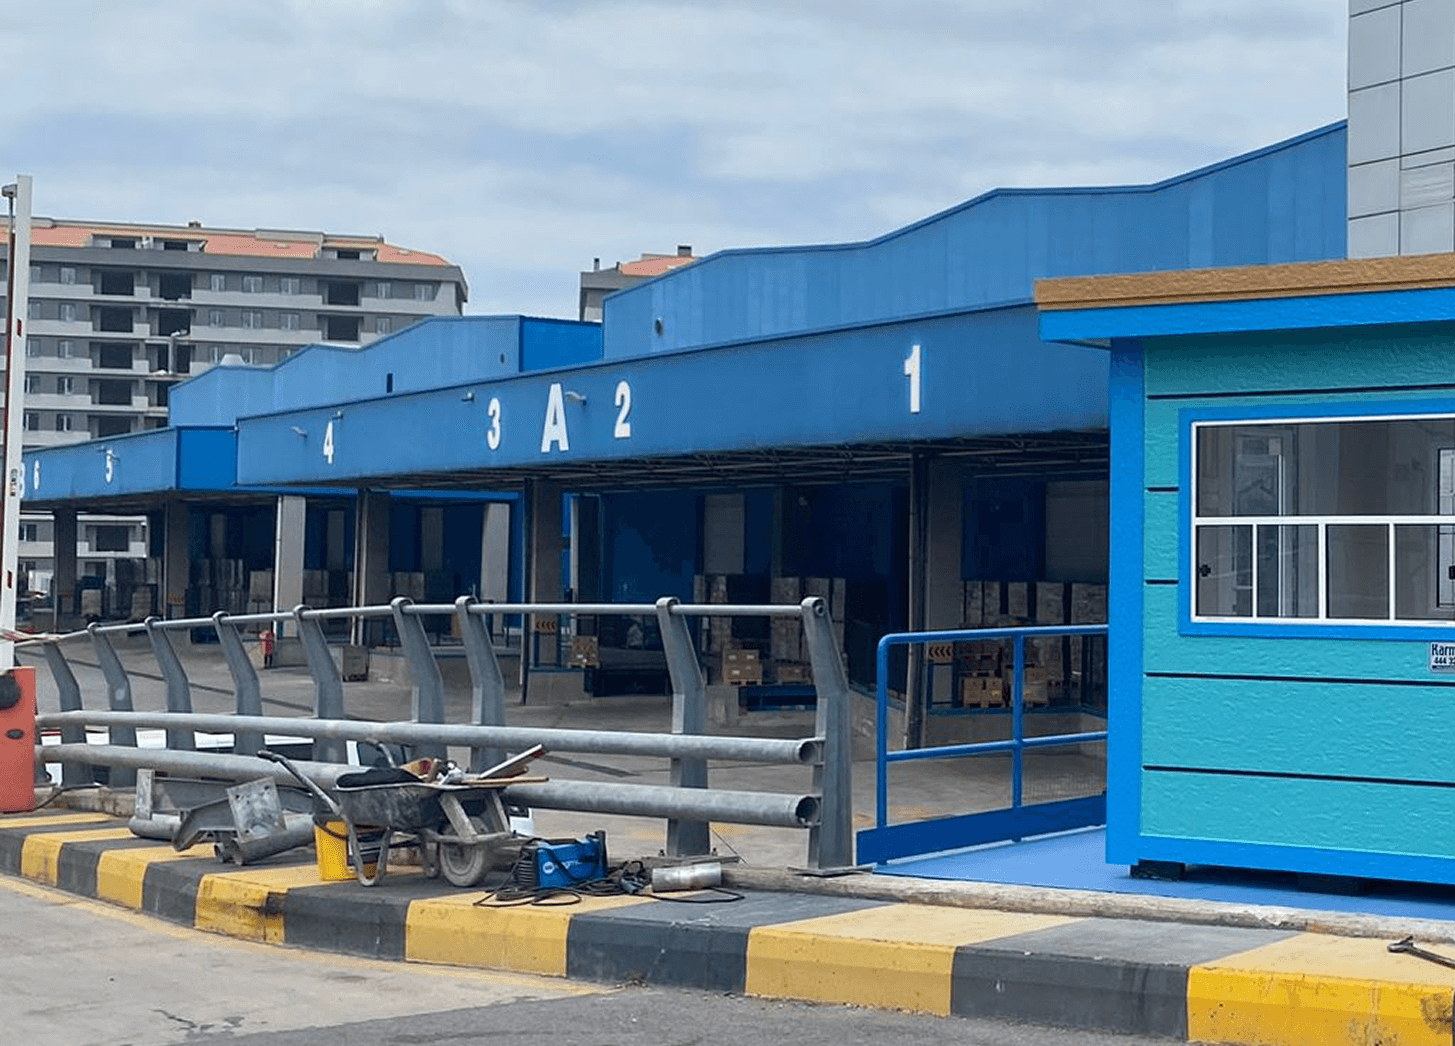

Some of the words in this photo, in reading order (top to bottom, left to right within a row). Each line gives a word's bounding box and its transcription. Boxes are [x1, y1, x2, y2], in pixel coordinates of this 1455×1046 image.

[904, 345, 920, 412] 1
[487, 397, 500, 450] 3
[541, 383, 569, 452] A
[614, 381, 631, 438] 2
[105, 449, 113, 483] 5
[323, 421, 334, 464] 4
[34, 459, 40, 490] 6
